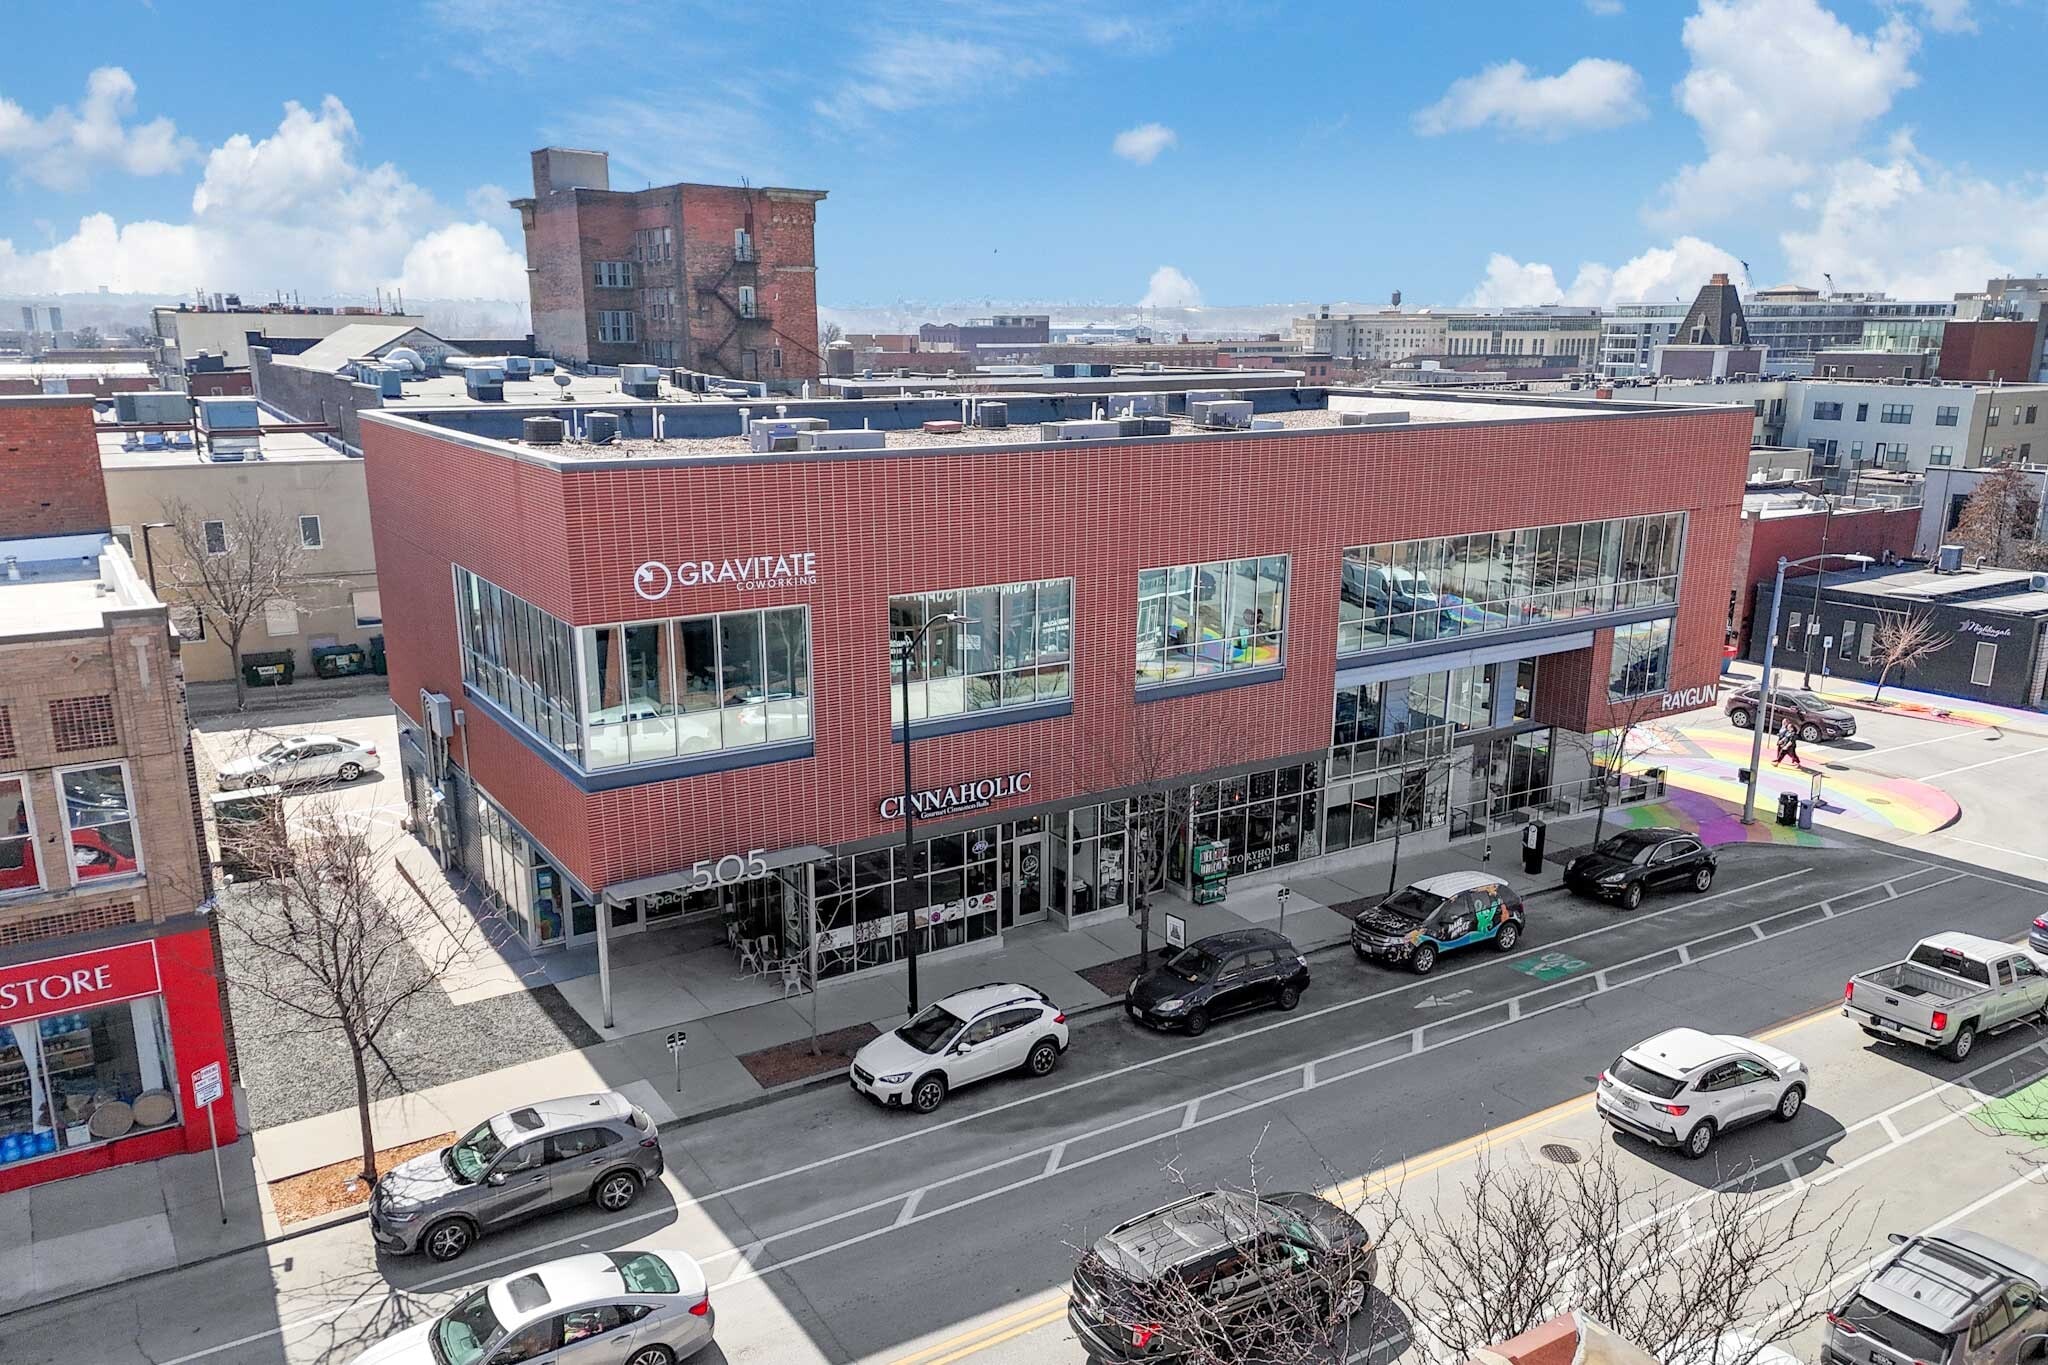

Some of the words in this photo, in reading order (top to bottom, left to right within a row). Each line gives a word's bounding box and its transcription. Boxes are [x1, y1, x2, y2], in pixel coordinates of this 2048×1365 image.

[677, 552, 817, 586] GRAVITATE
[736, 576, 817, 592] COWORKING
[1661, 683, 1718, 711] RAYGUN
[880, 771, 1032, 819] CINNAHOLIC
[691, 848, 767, 891] 505
[0, 964, 113, 1010] STORE
